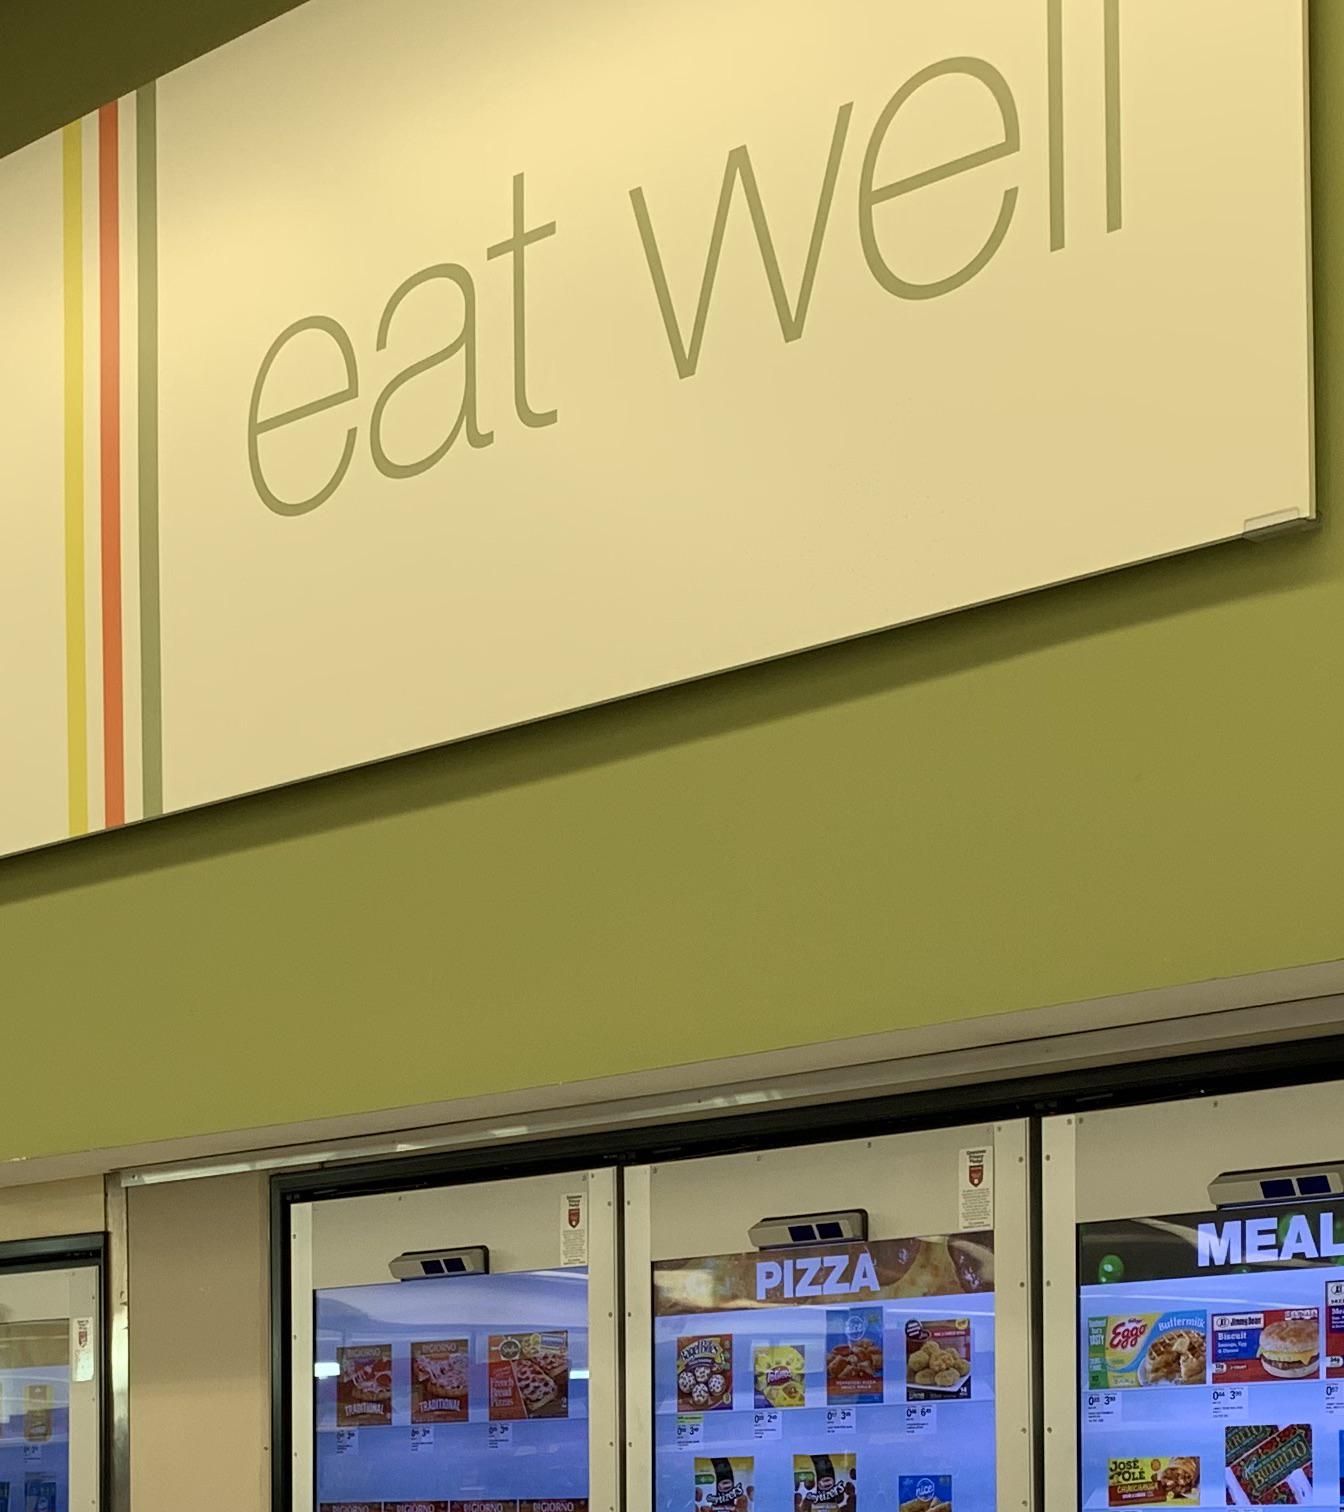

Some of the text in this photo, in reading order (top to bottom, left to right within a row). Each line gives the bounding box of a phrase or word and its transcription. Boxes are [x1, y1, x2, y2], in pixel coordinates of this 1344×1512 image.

[247, 0, 1122, 517] eat well
[756, 1252, 881, 1300] PIZZA
[1110, 1321, 1148, 1349] Eggo
[1159, 1318, 1205, 1331] Buttermilk
[1218, 1332, 1247, 1340] Biscuit
[1252, 1441, 1307, 1487] BURRITO
